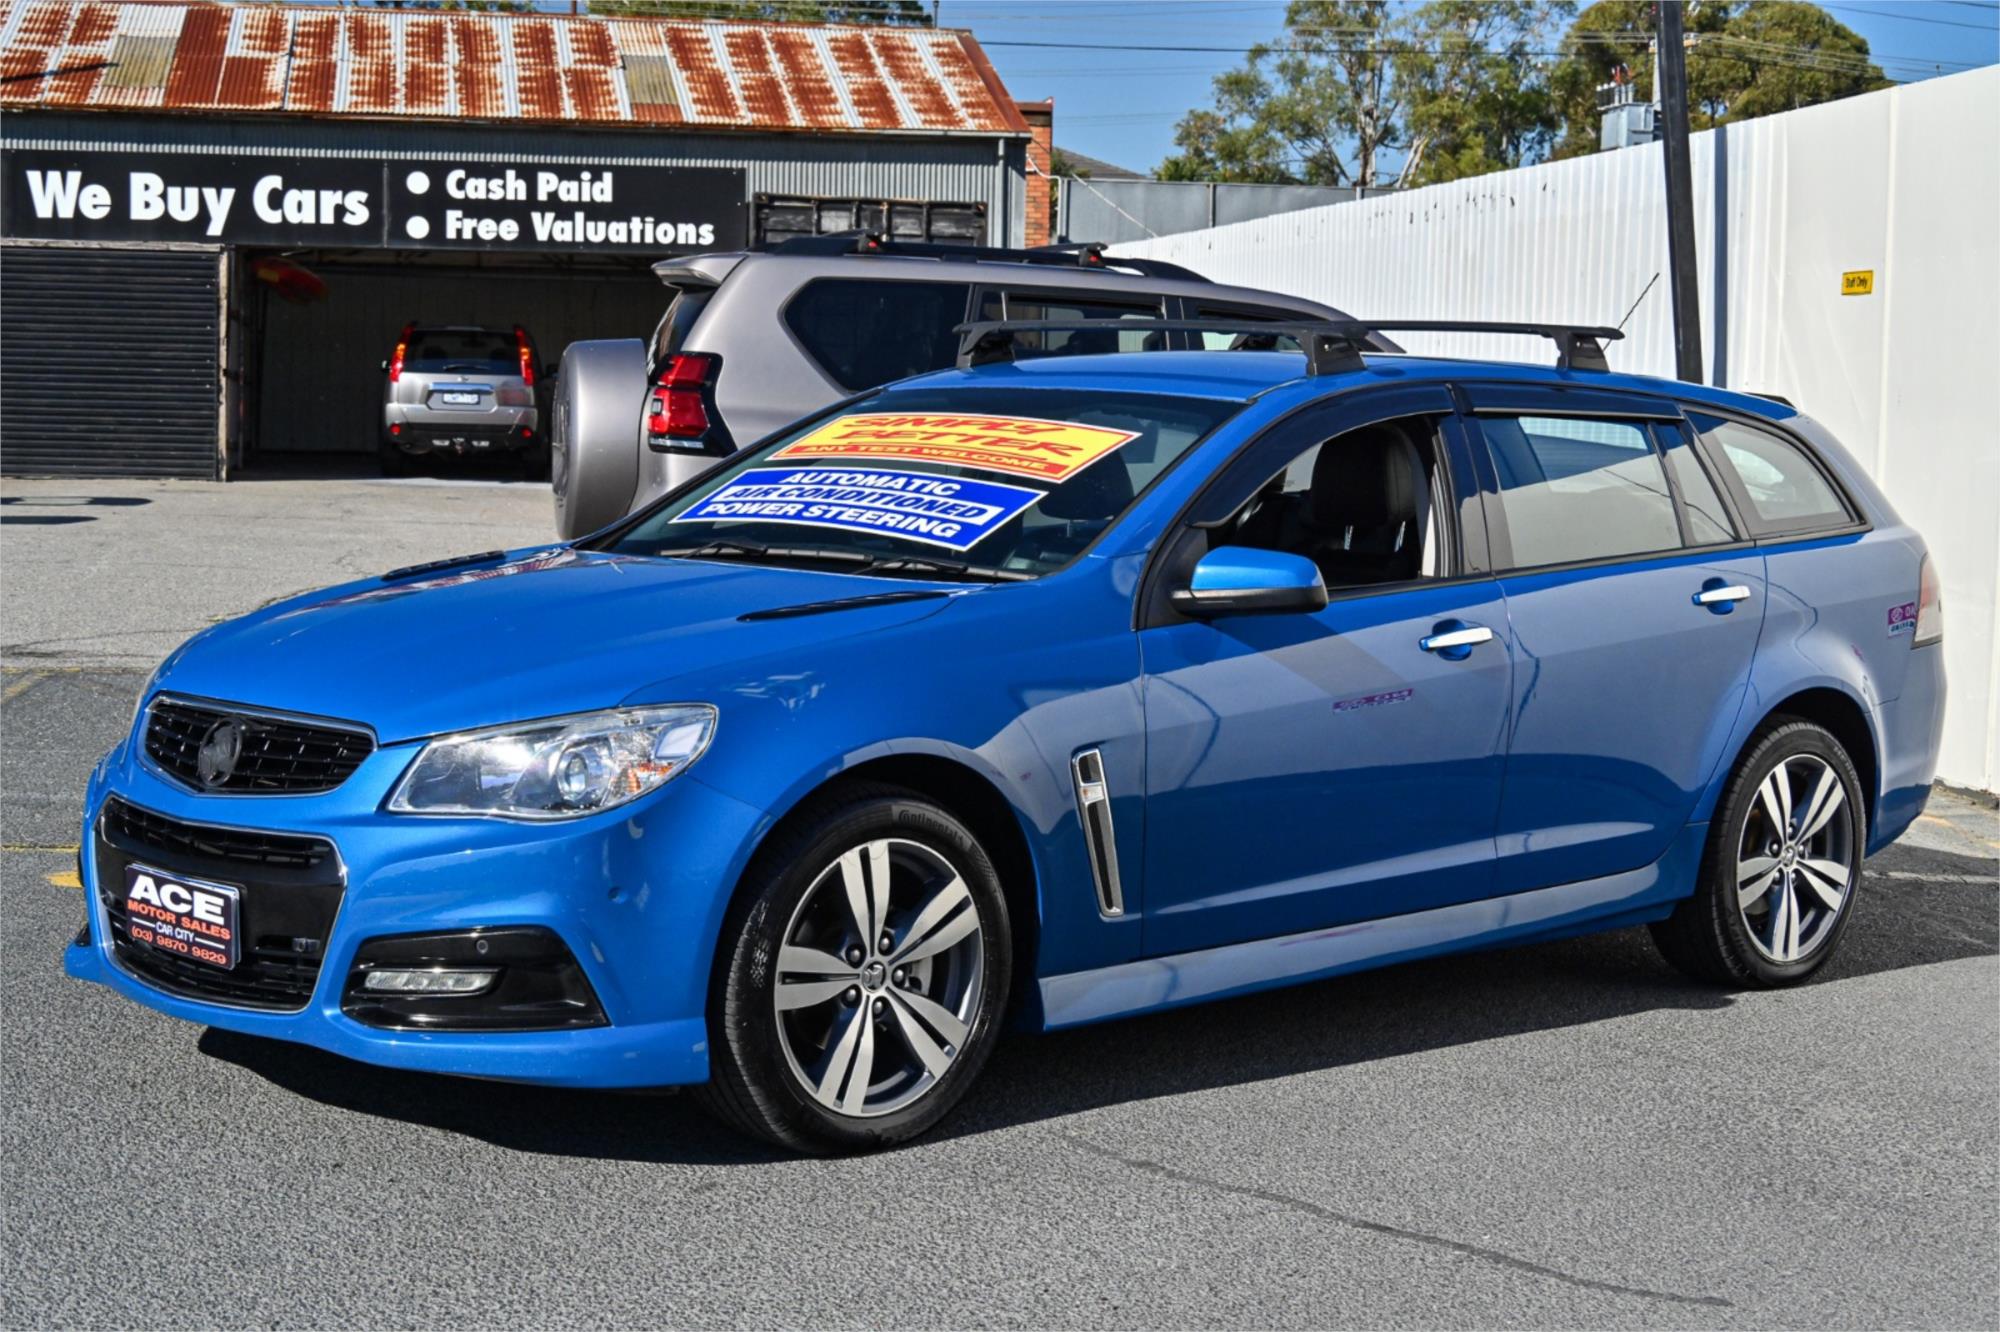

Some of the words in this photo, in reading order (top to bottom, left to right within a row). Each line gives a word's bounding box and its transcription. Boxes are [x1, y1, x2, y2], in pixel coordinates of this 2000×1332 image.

[446, 169, 527, 200] Cash
[537, 171, 613, 202] Paid
[26, 170, 112, 220] We
[130, 172, 236, 236] Buy
[253, 175, 370, 226] Cars
[446, 210, 519, 241] Free
[531, 211, 715, 245] Valuations
[844, 417, 1066, 434] SIMPLY
[832, 430, 1084, 457] BETTER
[858, 445, 913, 454] TEST
[922, 448, 1049, 470] WELCOME
[779, 471, 962, 496] AUTOMATIC
[697, 502, 803, 517] POWER
[803, 503, 962, 538] STEERING
[723, 486, 776, 499] AIR
[777, 486, 991, 520] CONDITIONED
[129, 874, 224, 925] ACE
[127, 900, 176, 924] MOTOR
[181, 917, 231, 940] SALES
[155, 922, 173, 936] CAR
[174, 927, 195, 942] CITY
[131, 926, 153, 942] (03)
[156, 935, 188, 952] 9870
[191, 946, 226, 964] 9829
